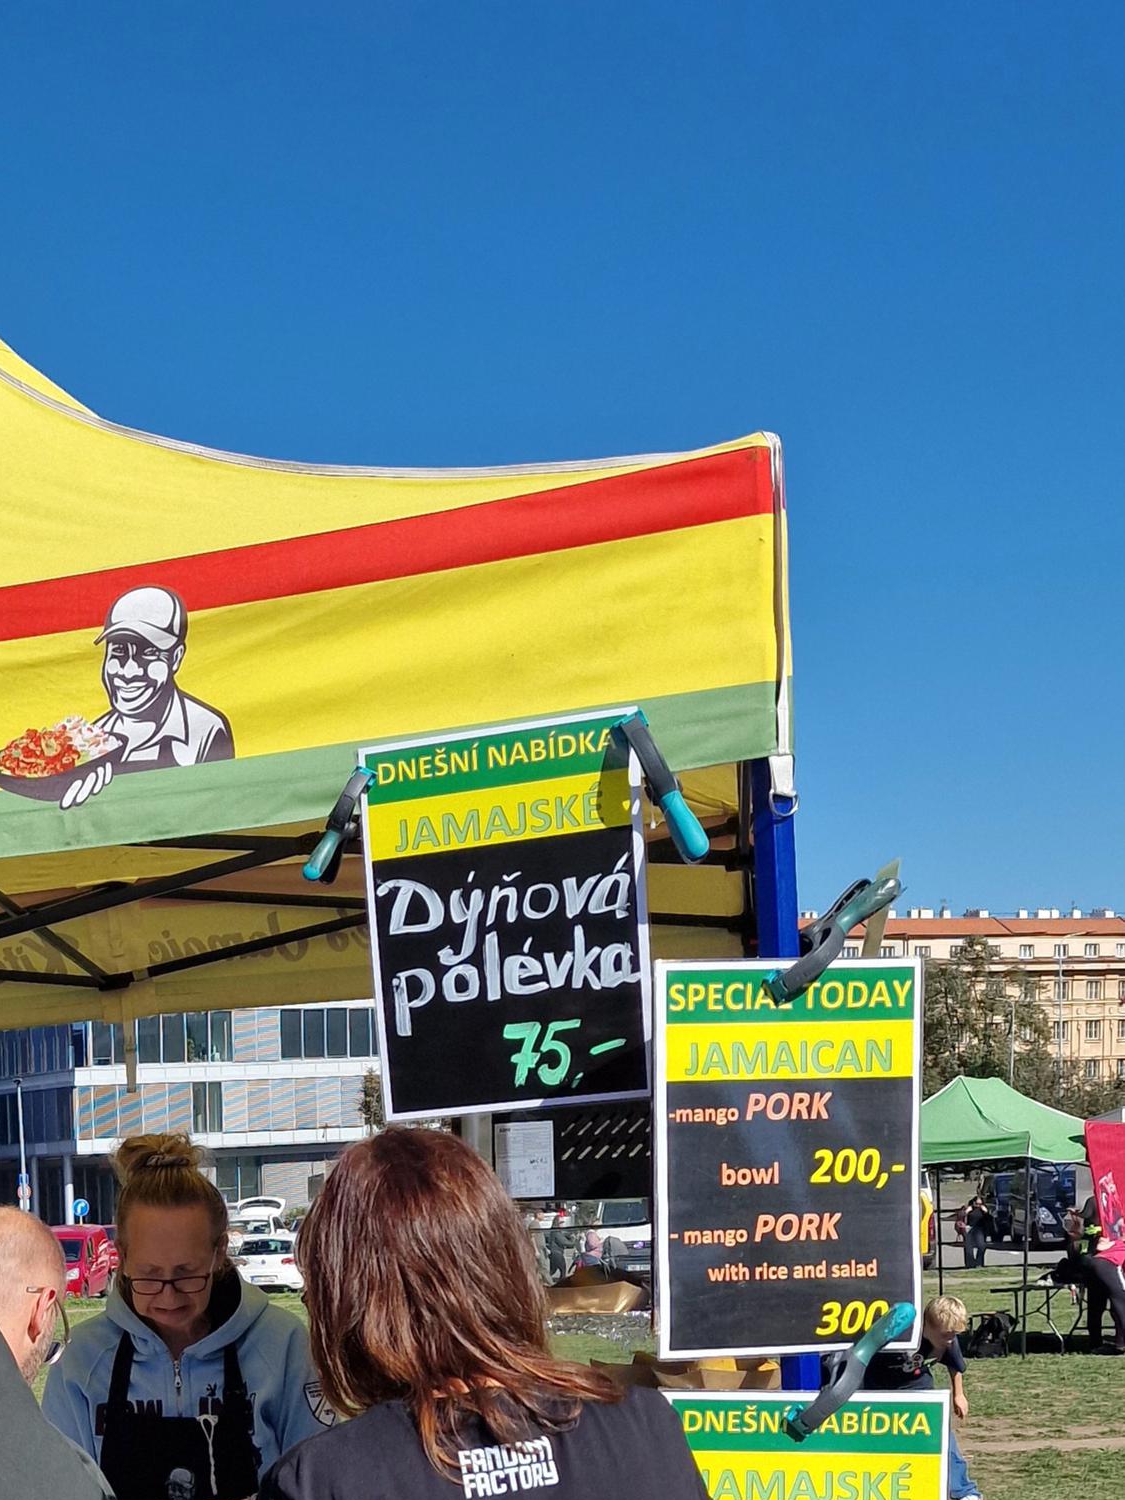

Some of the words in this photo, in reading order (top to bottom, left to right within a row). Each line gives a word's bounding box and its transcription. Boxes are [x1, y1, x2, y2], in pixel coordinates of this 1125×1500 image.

[377, 744, 479, 786] DNEŠNÍ
[487, 727, 616, 769] NABÍDKA
[395, 781, 604, 853] JAMAJSKÉ
[375, 851, 632, 965] Dýňová
[391, 925, 642, 1037] polévka
[669, 980, 793, 1012] SPECIA
[805, 979, 912, 1010] TODAY
[684, 1038, 893, 1077] JAMAICAN
[745, 1091, 833, 1122] PORK
[721, 1162, 780, 1187] bowl
[810, 1147, 906, 1190] 200,-
[683, 1229, 748, 1249] mango
[754, 1212, 842, 1243] PORK
[707, 1261, 750, 1283] with
[754, 1261, 789, 1281] rice
[792, 1259, 827, 1280] and
[831, 1257, 878, 1279] salad
[815, 1406, 931, 1436] ABÍDKA
[462, 1460, 560, 1500] FACTORY
